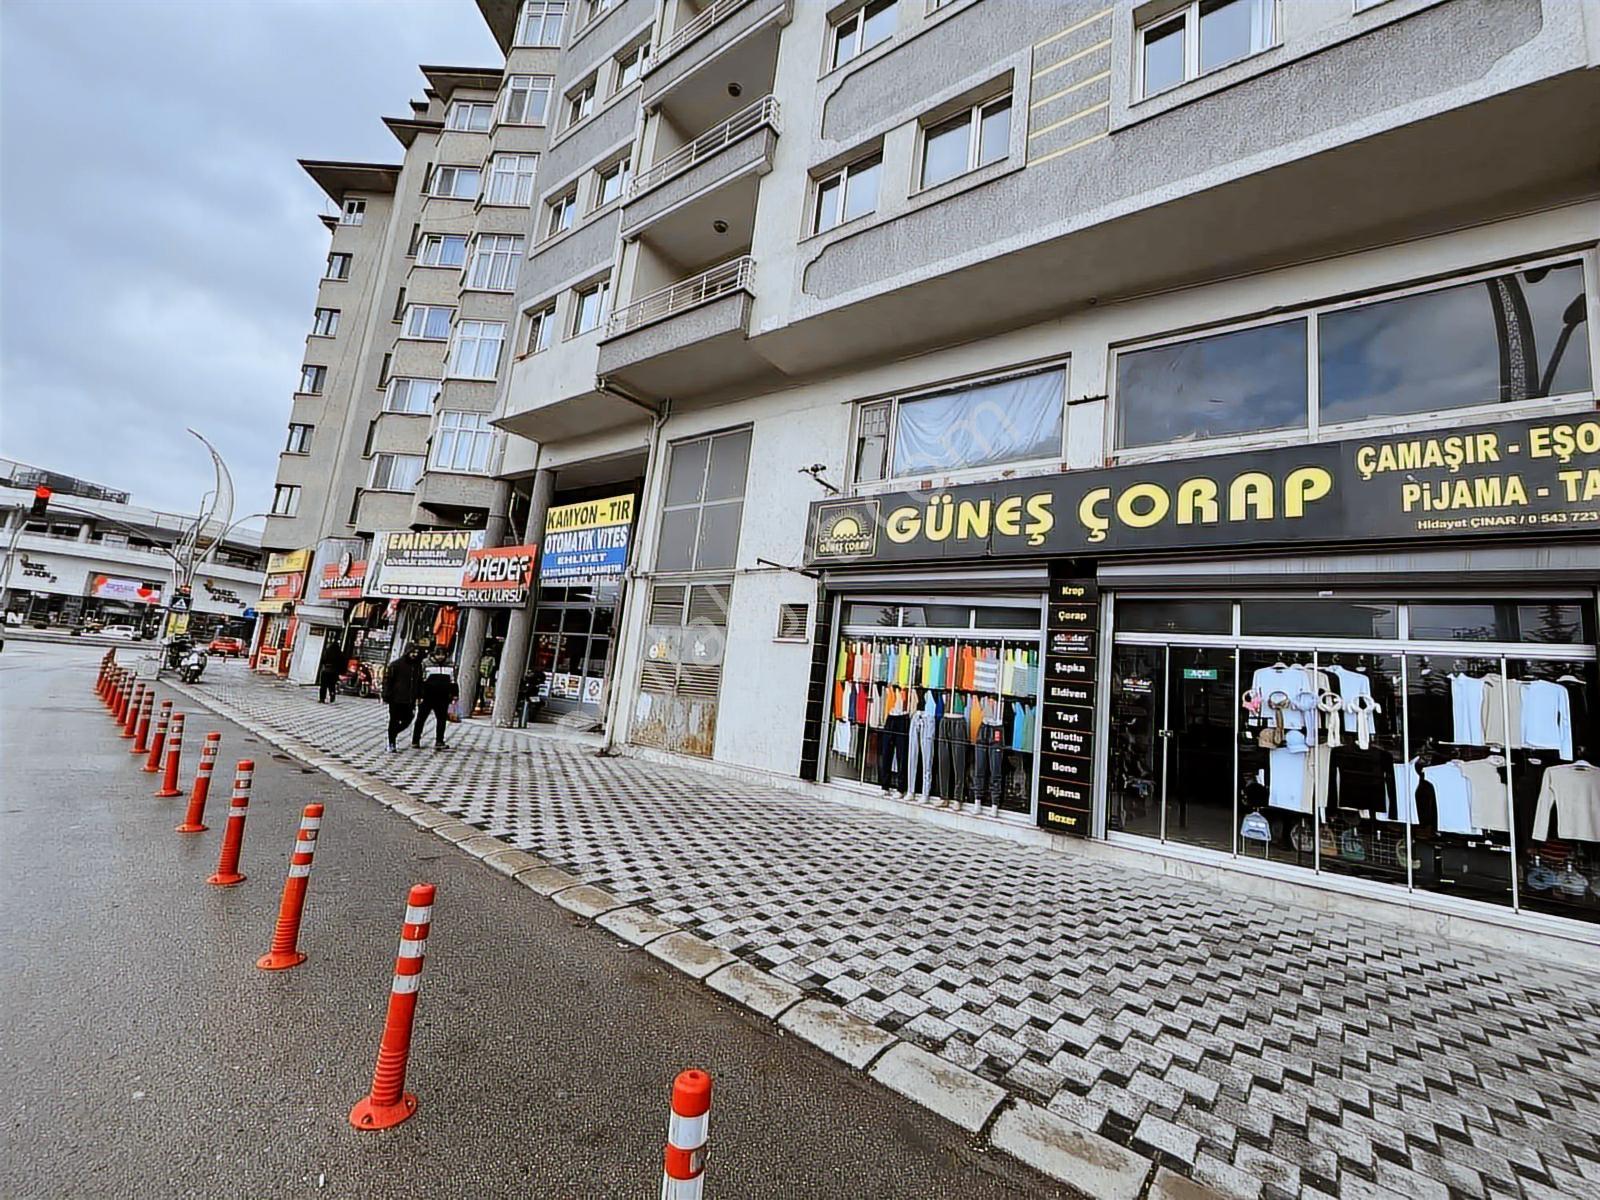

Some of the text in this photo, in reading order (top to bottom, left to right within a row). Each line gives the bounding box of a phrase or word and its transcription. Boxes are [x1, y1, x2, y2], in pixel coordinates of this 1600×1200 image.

[1356, 433, 1501, 480] ÇAMAŞIR
[885, 466, 1332, 546] GÜNEŞ ÇORAP
[547, 504, 598, 530] KAMYON
[609, 500, 631, 521] TIR
[1418, 518, 1467, 530] Hidayet
[1470, 516, 1519, 529] ÇINAR
[1541, 513, 1567, 523] 543
[477, 555, 531, 581] HEDEF
[1062, 586, 1085, 597] Krop
[1058, 611, 1087, 622] Çorap
[1055, 662, 1086, 673] Şapka
[1051, 687, 1087, 699] Eldiven
[1056, 711, 1079, 723] Tayt
[1050, 731, 1083, 743] Kilotlu
[1051, 741, 1081, 753] Çorap
[1052, 761, 1078, 774] Bone
[1046, 785, 1081, 800] Pijama
[1048, 811, 1077, 825] Boxer
